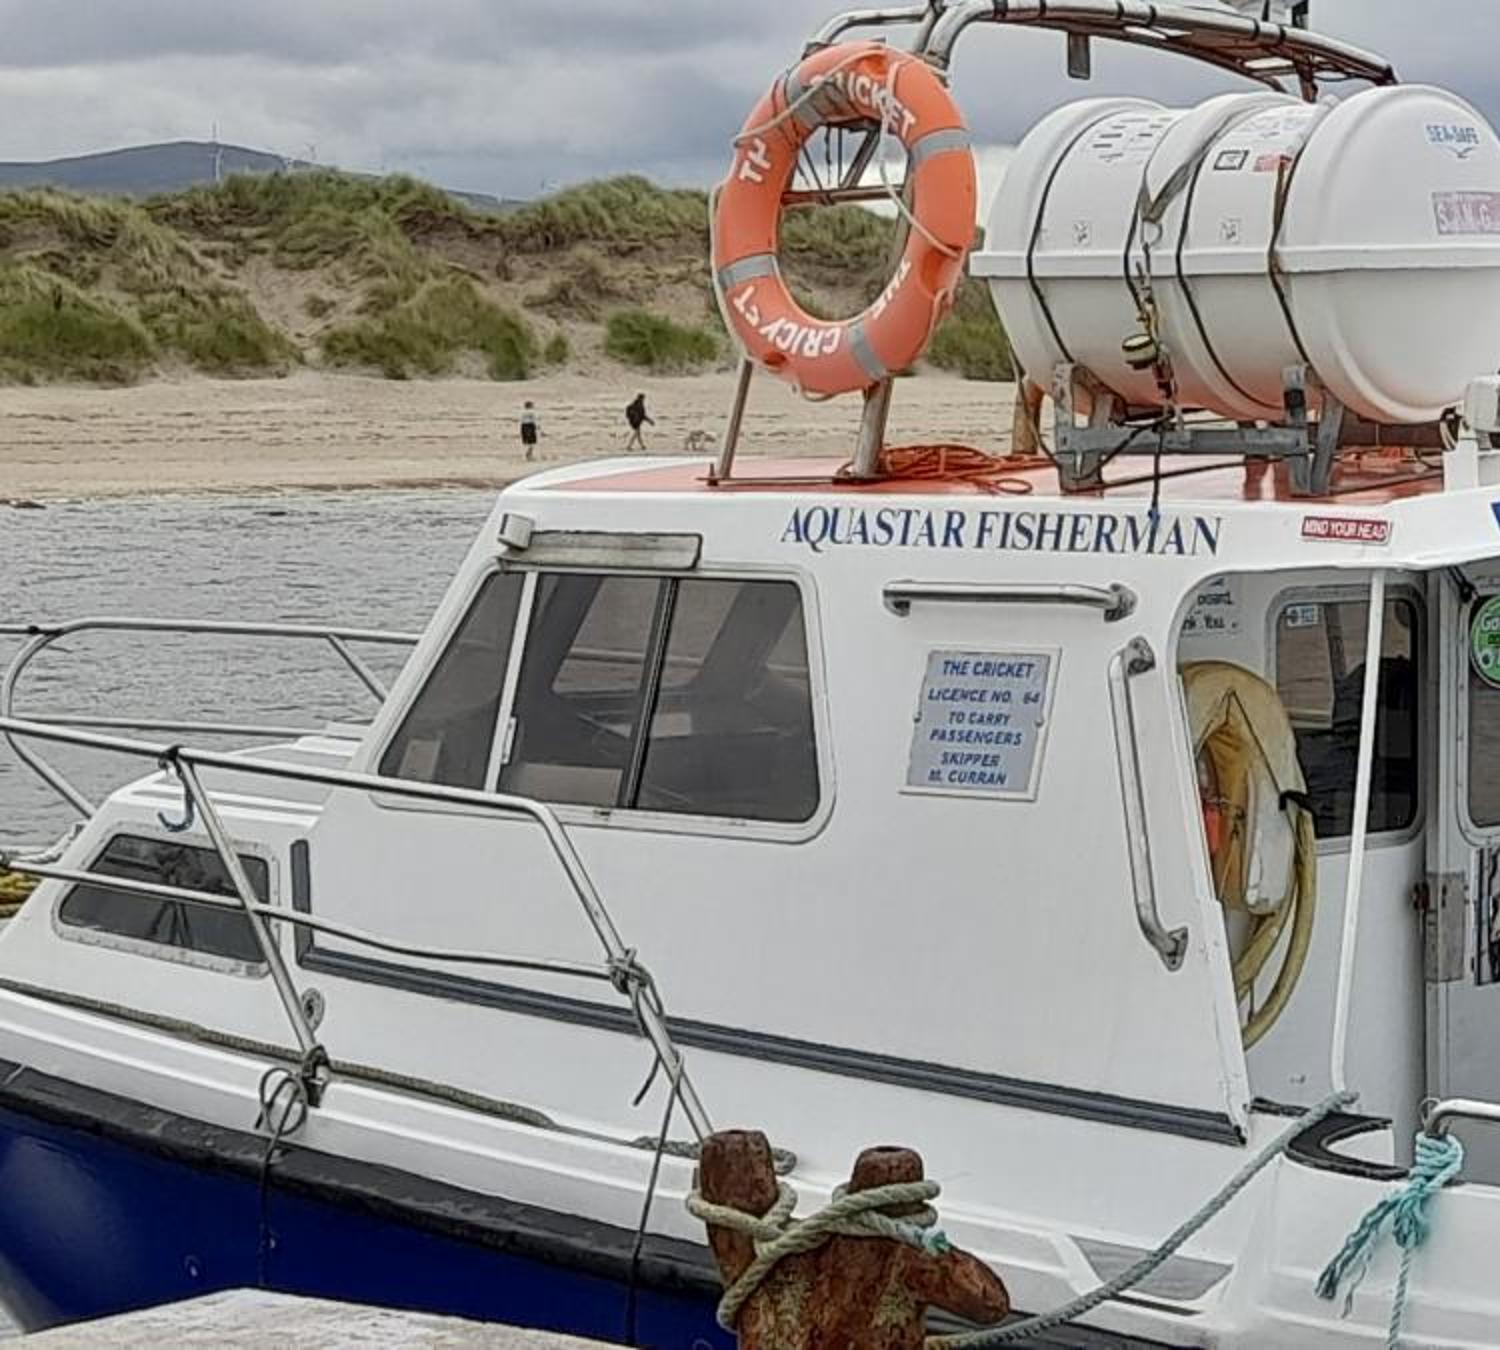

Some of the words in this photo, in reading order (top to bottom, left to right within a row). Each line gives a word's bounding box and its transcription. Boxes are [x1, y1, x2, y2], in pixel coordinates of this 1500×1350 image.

[781, 505, 966, 553] AQUASTAR
[976, 512, 1222, 557] FISHERMAN
[1330, 521, 1357, 537] YOUR
[1357, 523, 1387, 539] HEAD
[943, 660, 970, 676] THE
[973, 661, 1035, 678] CRICKET
[928, 687, 987, 702] LICENCE
[949, 711, 965, 725] TO
[969, 712, 1010, 726] CARRY
[929, 729, 1022, 746] PASSENGERS
[941, 751, 1001, 767] SKIPPER
[948, 769, 1007, 785] CURRAN
